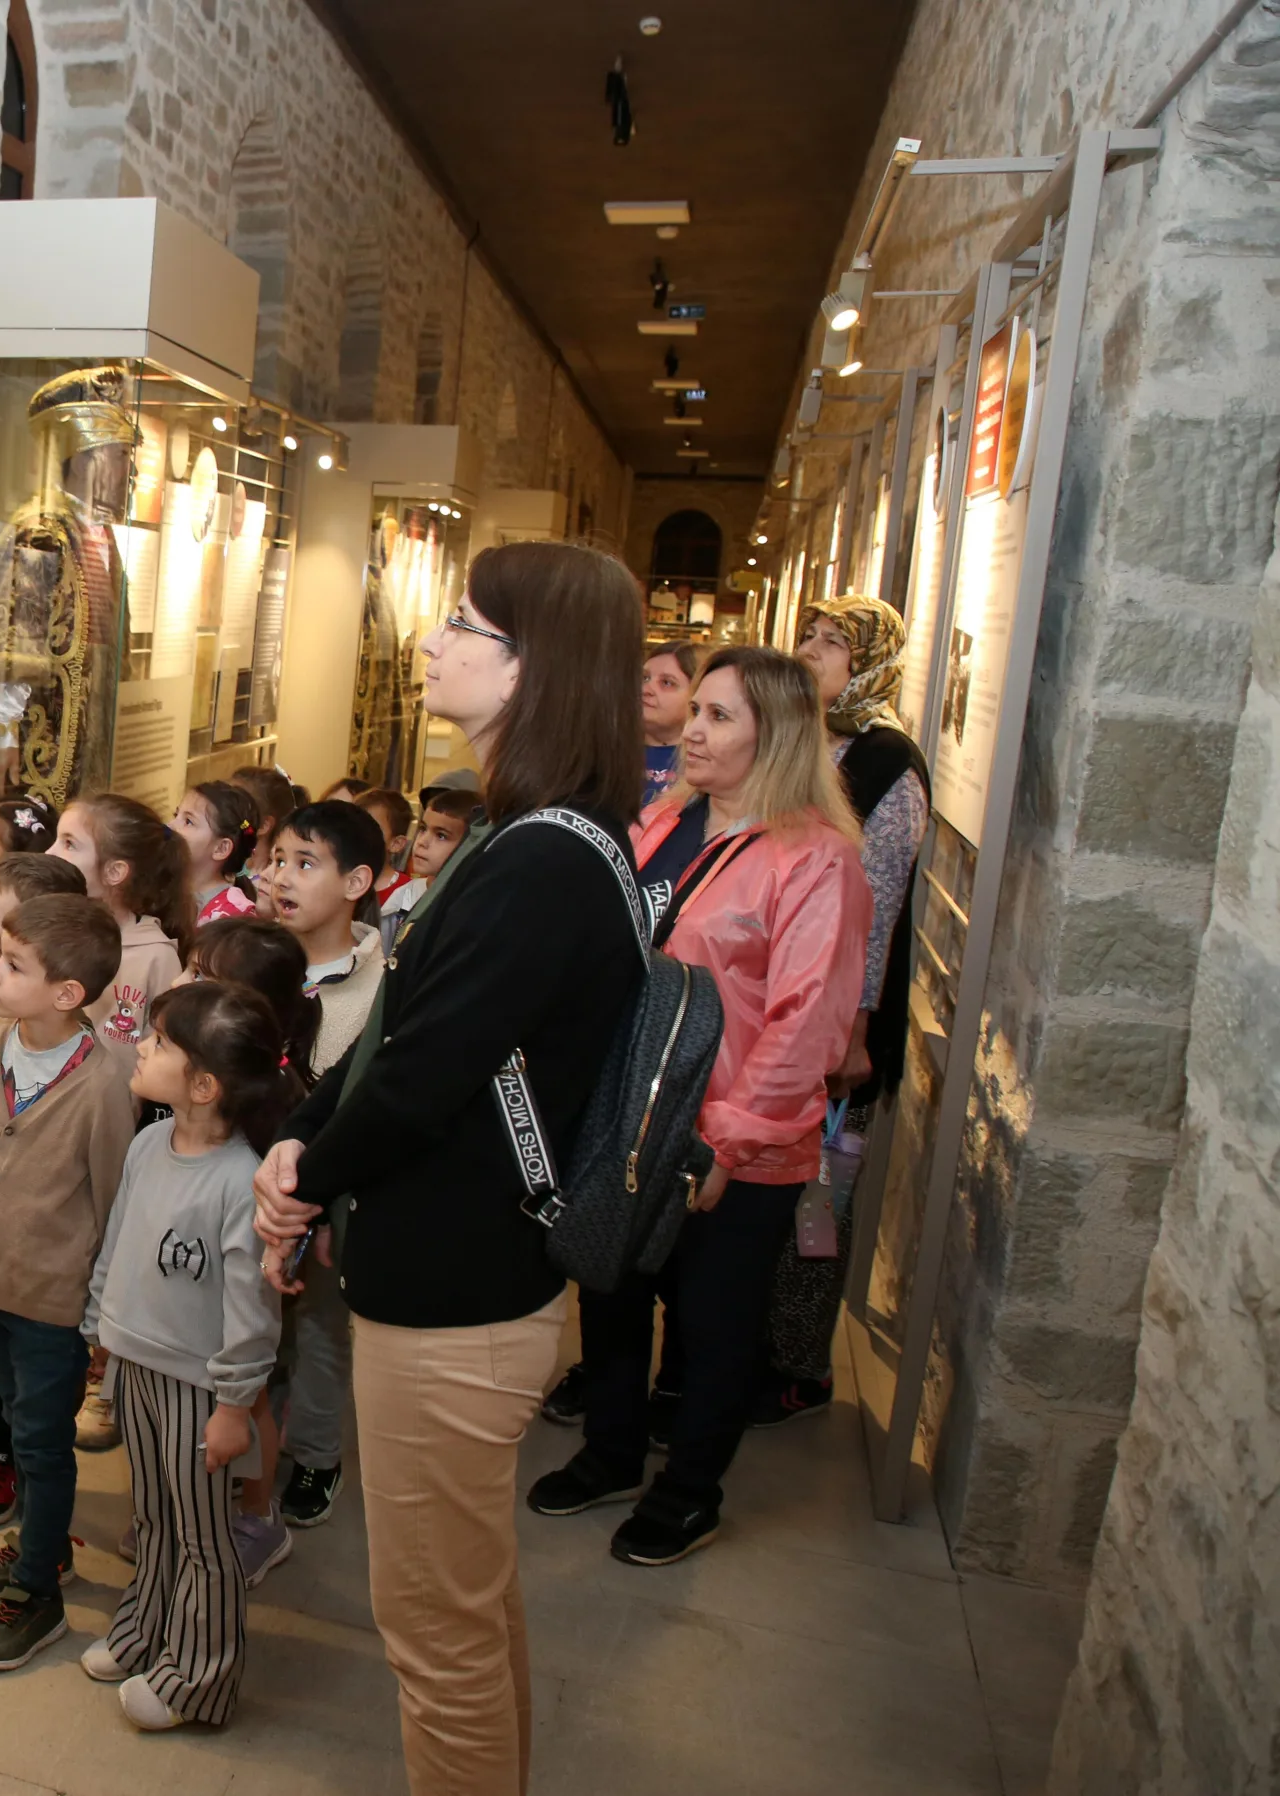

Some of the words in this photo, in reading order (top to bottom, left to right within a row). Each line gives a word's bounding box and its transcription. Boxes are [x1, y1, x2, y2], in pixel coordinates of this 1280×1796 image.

[571, 818, 616, 858] KORS
[114, 985, 148, 1009] LOVE
[103, 1025, 140, 1045] YOURSELF
[499, 1064, 531, 1128] MICHA
[519, 1131, 547, 1185] KORS
